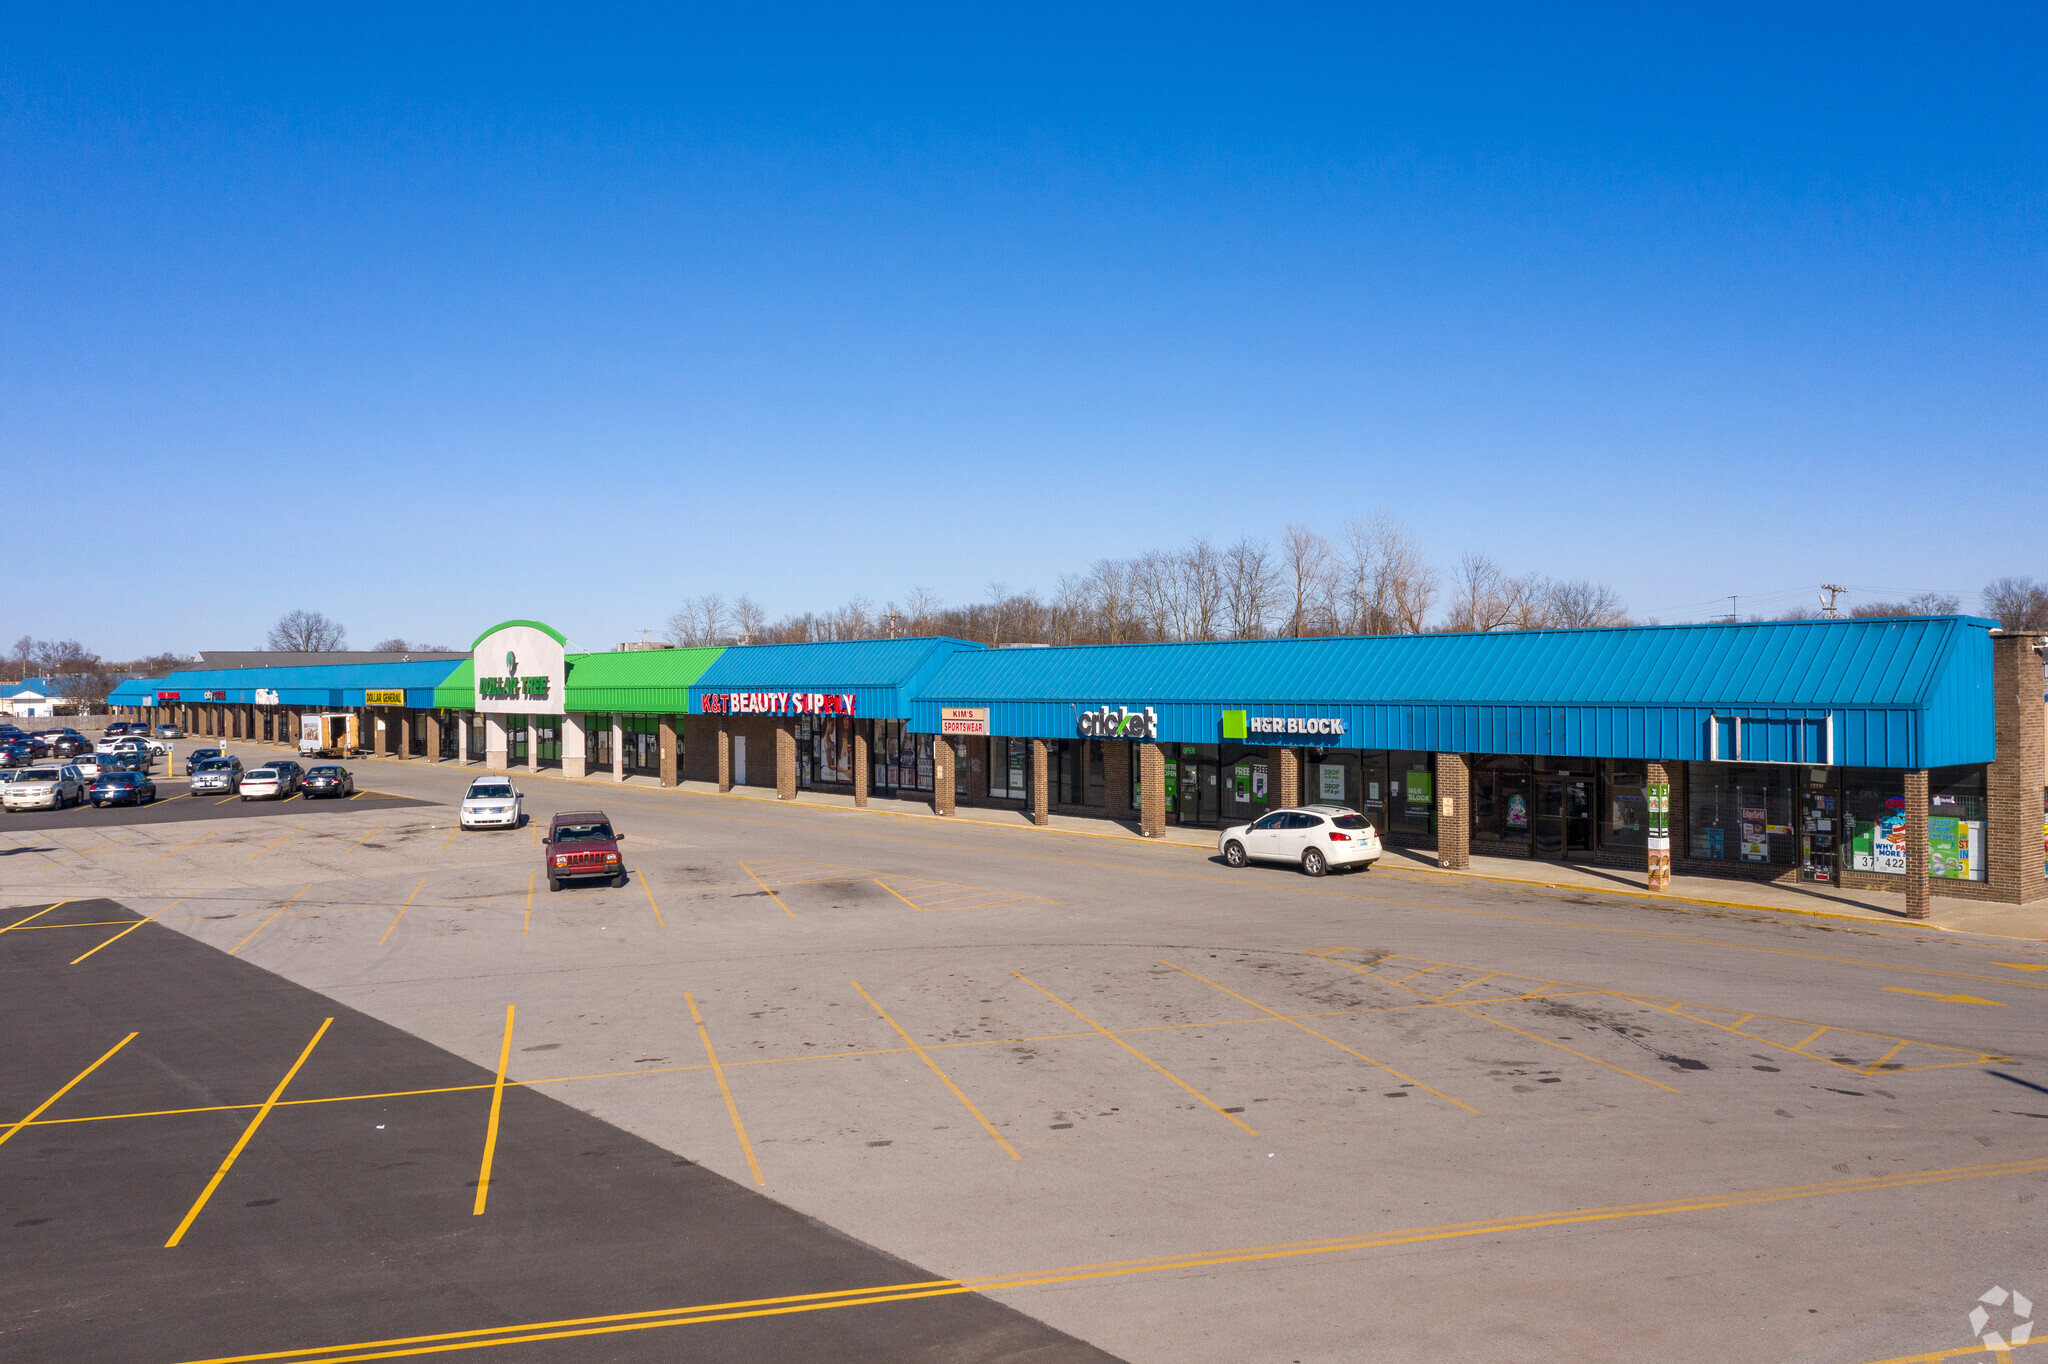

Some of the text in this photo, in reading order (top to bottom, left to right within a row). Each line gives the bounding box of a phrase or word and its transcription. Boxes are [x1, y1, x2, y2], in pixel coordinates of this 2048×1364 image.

[479, 676, 548, 695] DOLLAR TREE
[366, 692, 402, 704] DOLLAR GENERAL
[701, 694, 729, 713] K&T
[730, 692, 791, 714] BEAUTY
[952, 710, 974, 718] KIM'S
[944, 722, 983, 732] SPORTSWEAR
[1078, 706, 1157, 739] cricket
[1250, 716, 1345, 735] H&R BLOCK
[1183, 747, 1195, 755] OPEN
[1235, 766, 1250, 776] FREE
[1253, 765, 1268, 774] FREE
[1879, 849, 1901, 857] MORE
[1885, 858, 1905, 869] 422
